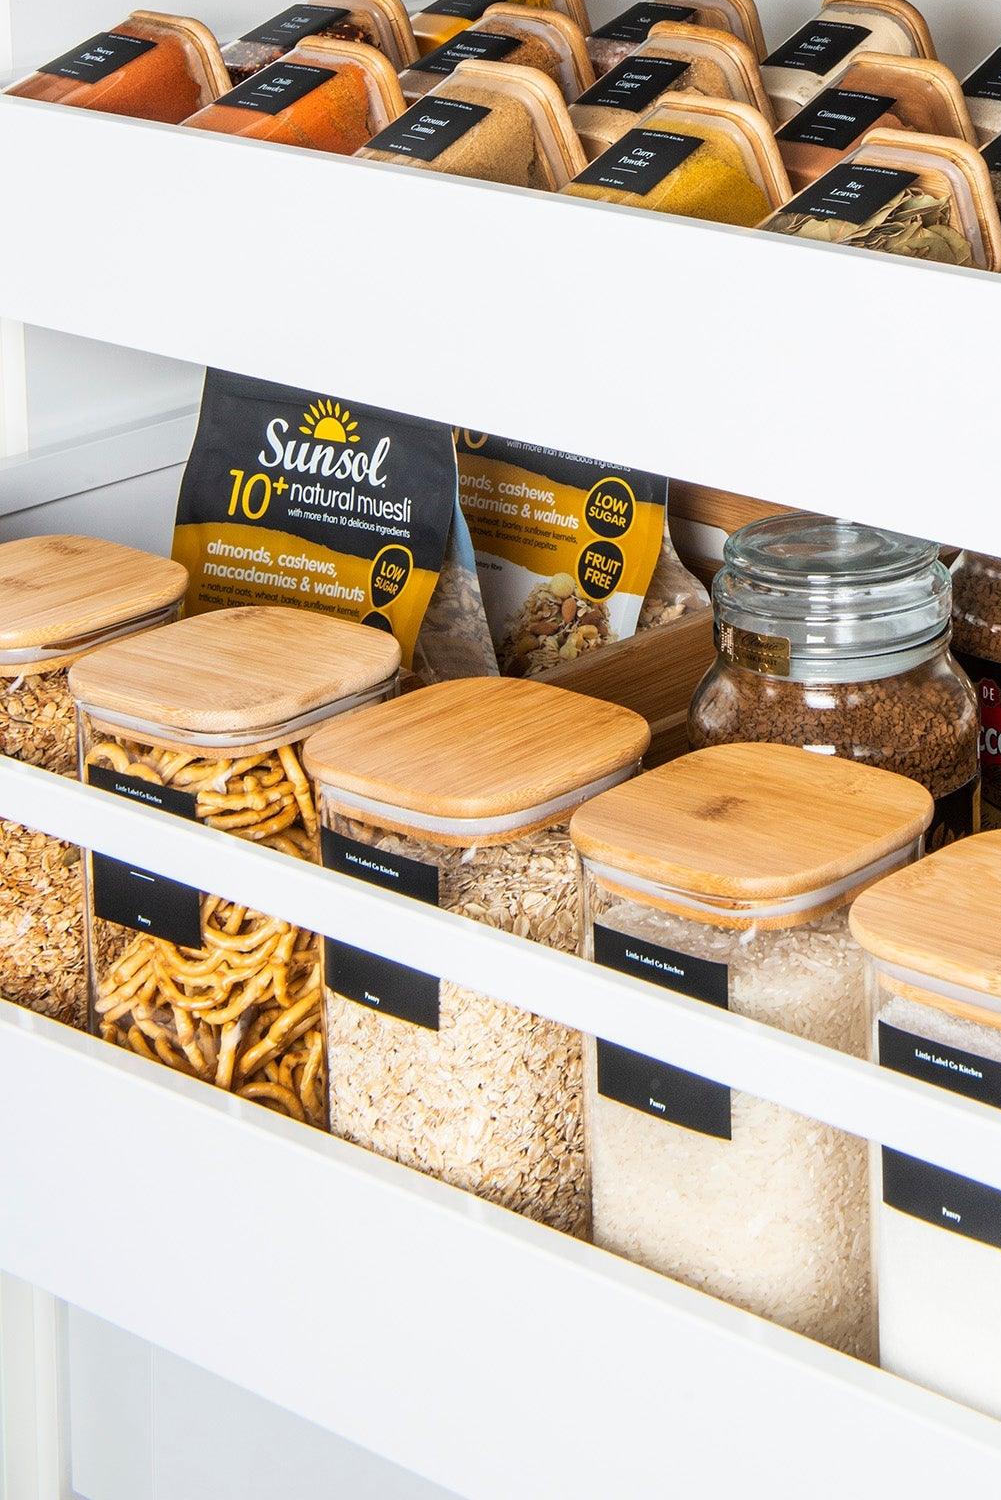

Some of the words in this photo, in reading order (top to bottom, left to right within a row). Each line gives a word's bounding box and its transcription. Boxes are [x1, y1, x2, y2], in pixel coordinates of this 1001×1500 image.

[622, 72, 653, 82] Ground
[419, 114, 450, 127] Ground
[816, 108, 856, 123] Cinnamon
[410, 123, 436, 136] Cumin
[619, 155, 650, 168] Powder
[631, 147, 657, 159] Curry
[829, 188, 861, 199] Leaves
[845, 180, 864, 192] Bay
[257, 417, 391, 488] Sunsol
[459, 474, 495, 493] onds,
[498, 481, 556, 506] cashews,
[290, 482, 355, 512] natural
[357, 497, 412, 524] muesli
[460, 492, 519, 516] adamias
[520, 504, 531, 518] &
[533, 508, 580, 530] walnuts
[594, 491, 629, 515] LOW
[287, 508, 303, 518] with
[303, 511, 321, 521] more
[321, 512, 338, 524] than
[339, 515, 347, 526] 10
[347, 516, 375, 532] delicious
[375, 522, 411, 539] ingredients
[588, 506, 627, 528] SUGAR
[206, 538, 274, 567] almonds,
[277, 553, 337, 578] cashews,
[585, 551, 622, 575] FRUIT
[203, 561, 298, 591] macadamias
[299, 576, 310, 593] &
[313, 581, 366, 603] walnuts
[380, 560, 406, 582] LOW
[584, 567, 613, 590] FREE
[374, 576, 398, 595] SUGAR
[915, 1048, 931, 1062] Little
[931, 1054, 948, 1067] Label
[948, 1060, 958, 1070] Co
[958, 1062, 983, 1079] Kitchen
